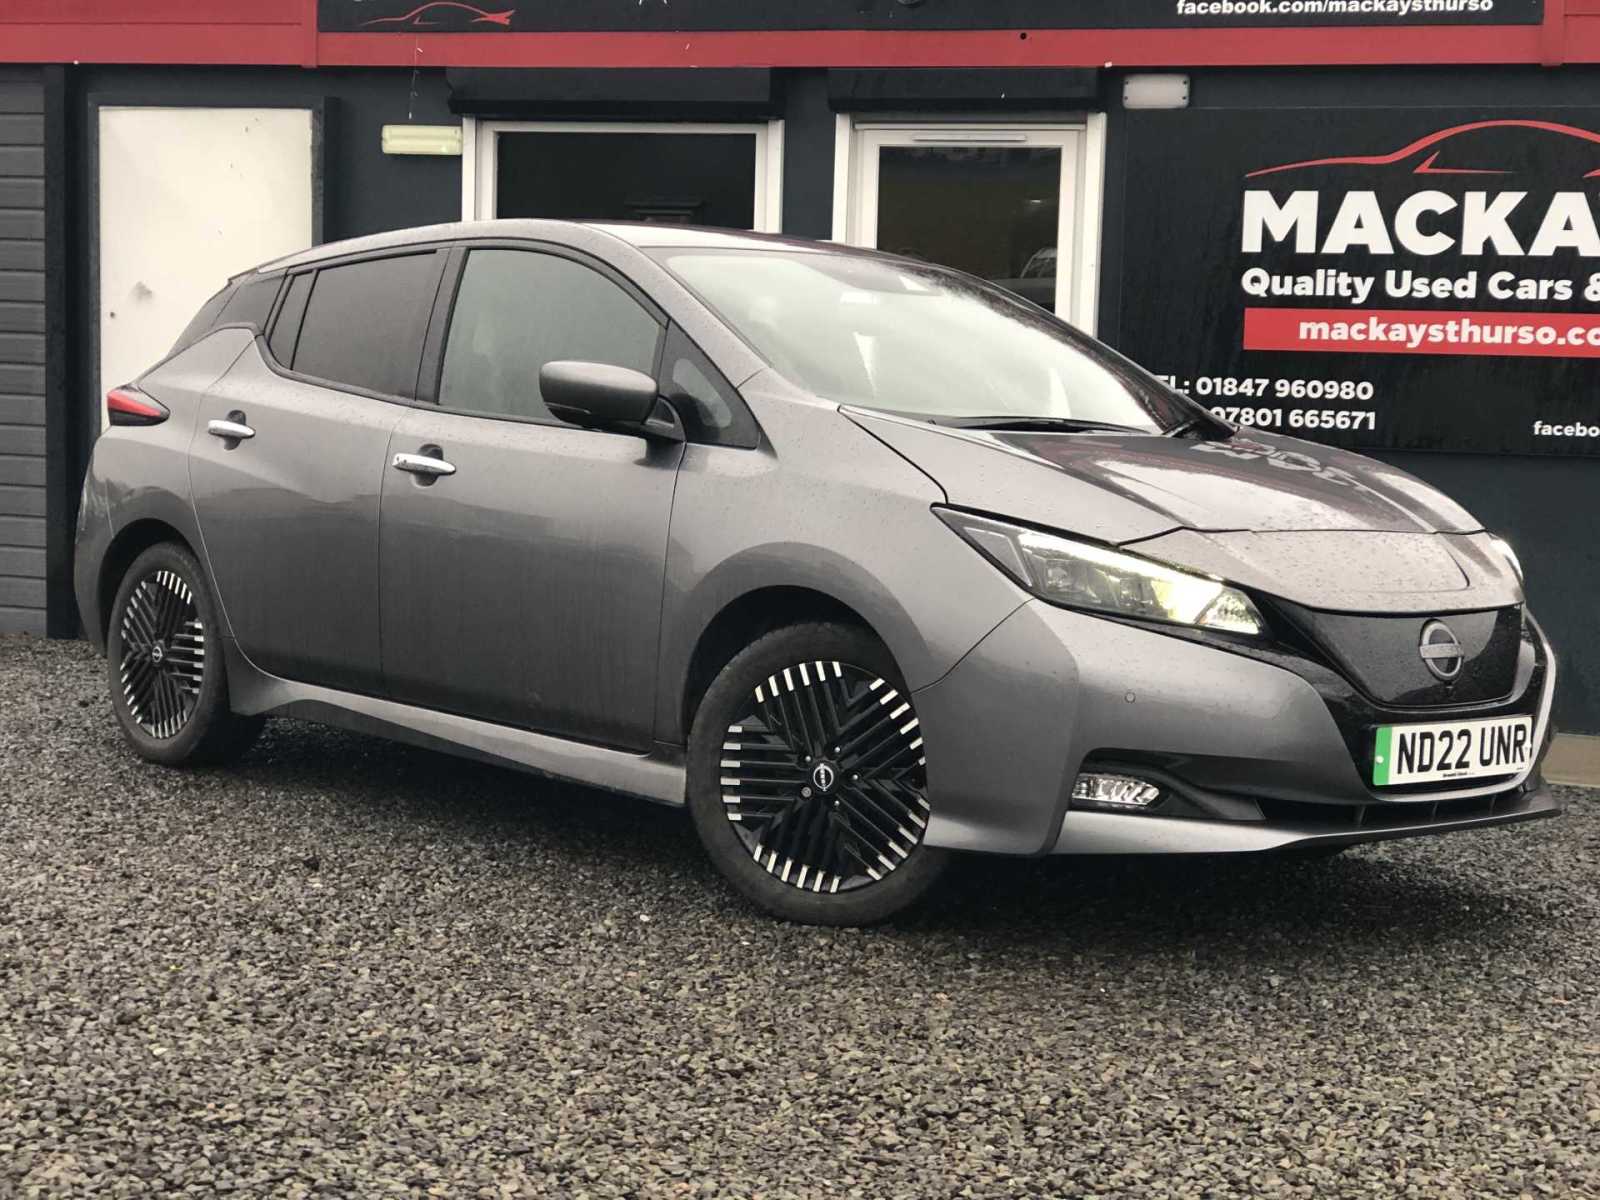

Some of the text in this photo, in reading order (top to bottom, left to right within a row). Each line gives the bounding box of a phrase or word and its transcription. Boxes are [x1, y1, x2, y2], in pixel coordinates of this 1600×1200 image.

[1176, 0, 1493, 15] facebook.com/mackaysthurso
[1241, 268, 1375, 304] Quality
[1385, 269, 1477, 299] Used
[1488, 271, 1573, 301] Cars
[1196, 377, 1269, 397] 01847
[1275, 379, 1374, 400] 960980
[1289, 409, 1376, 430] 665671
[1397, 724, 1527, 775] ND22 UNR
